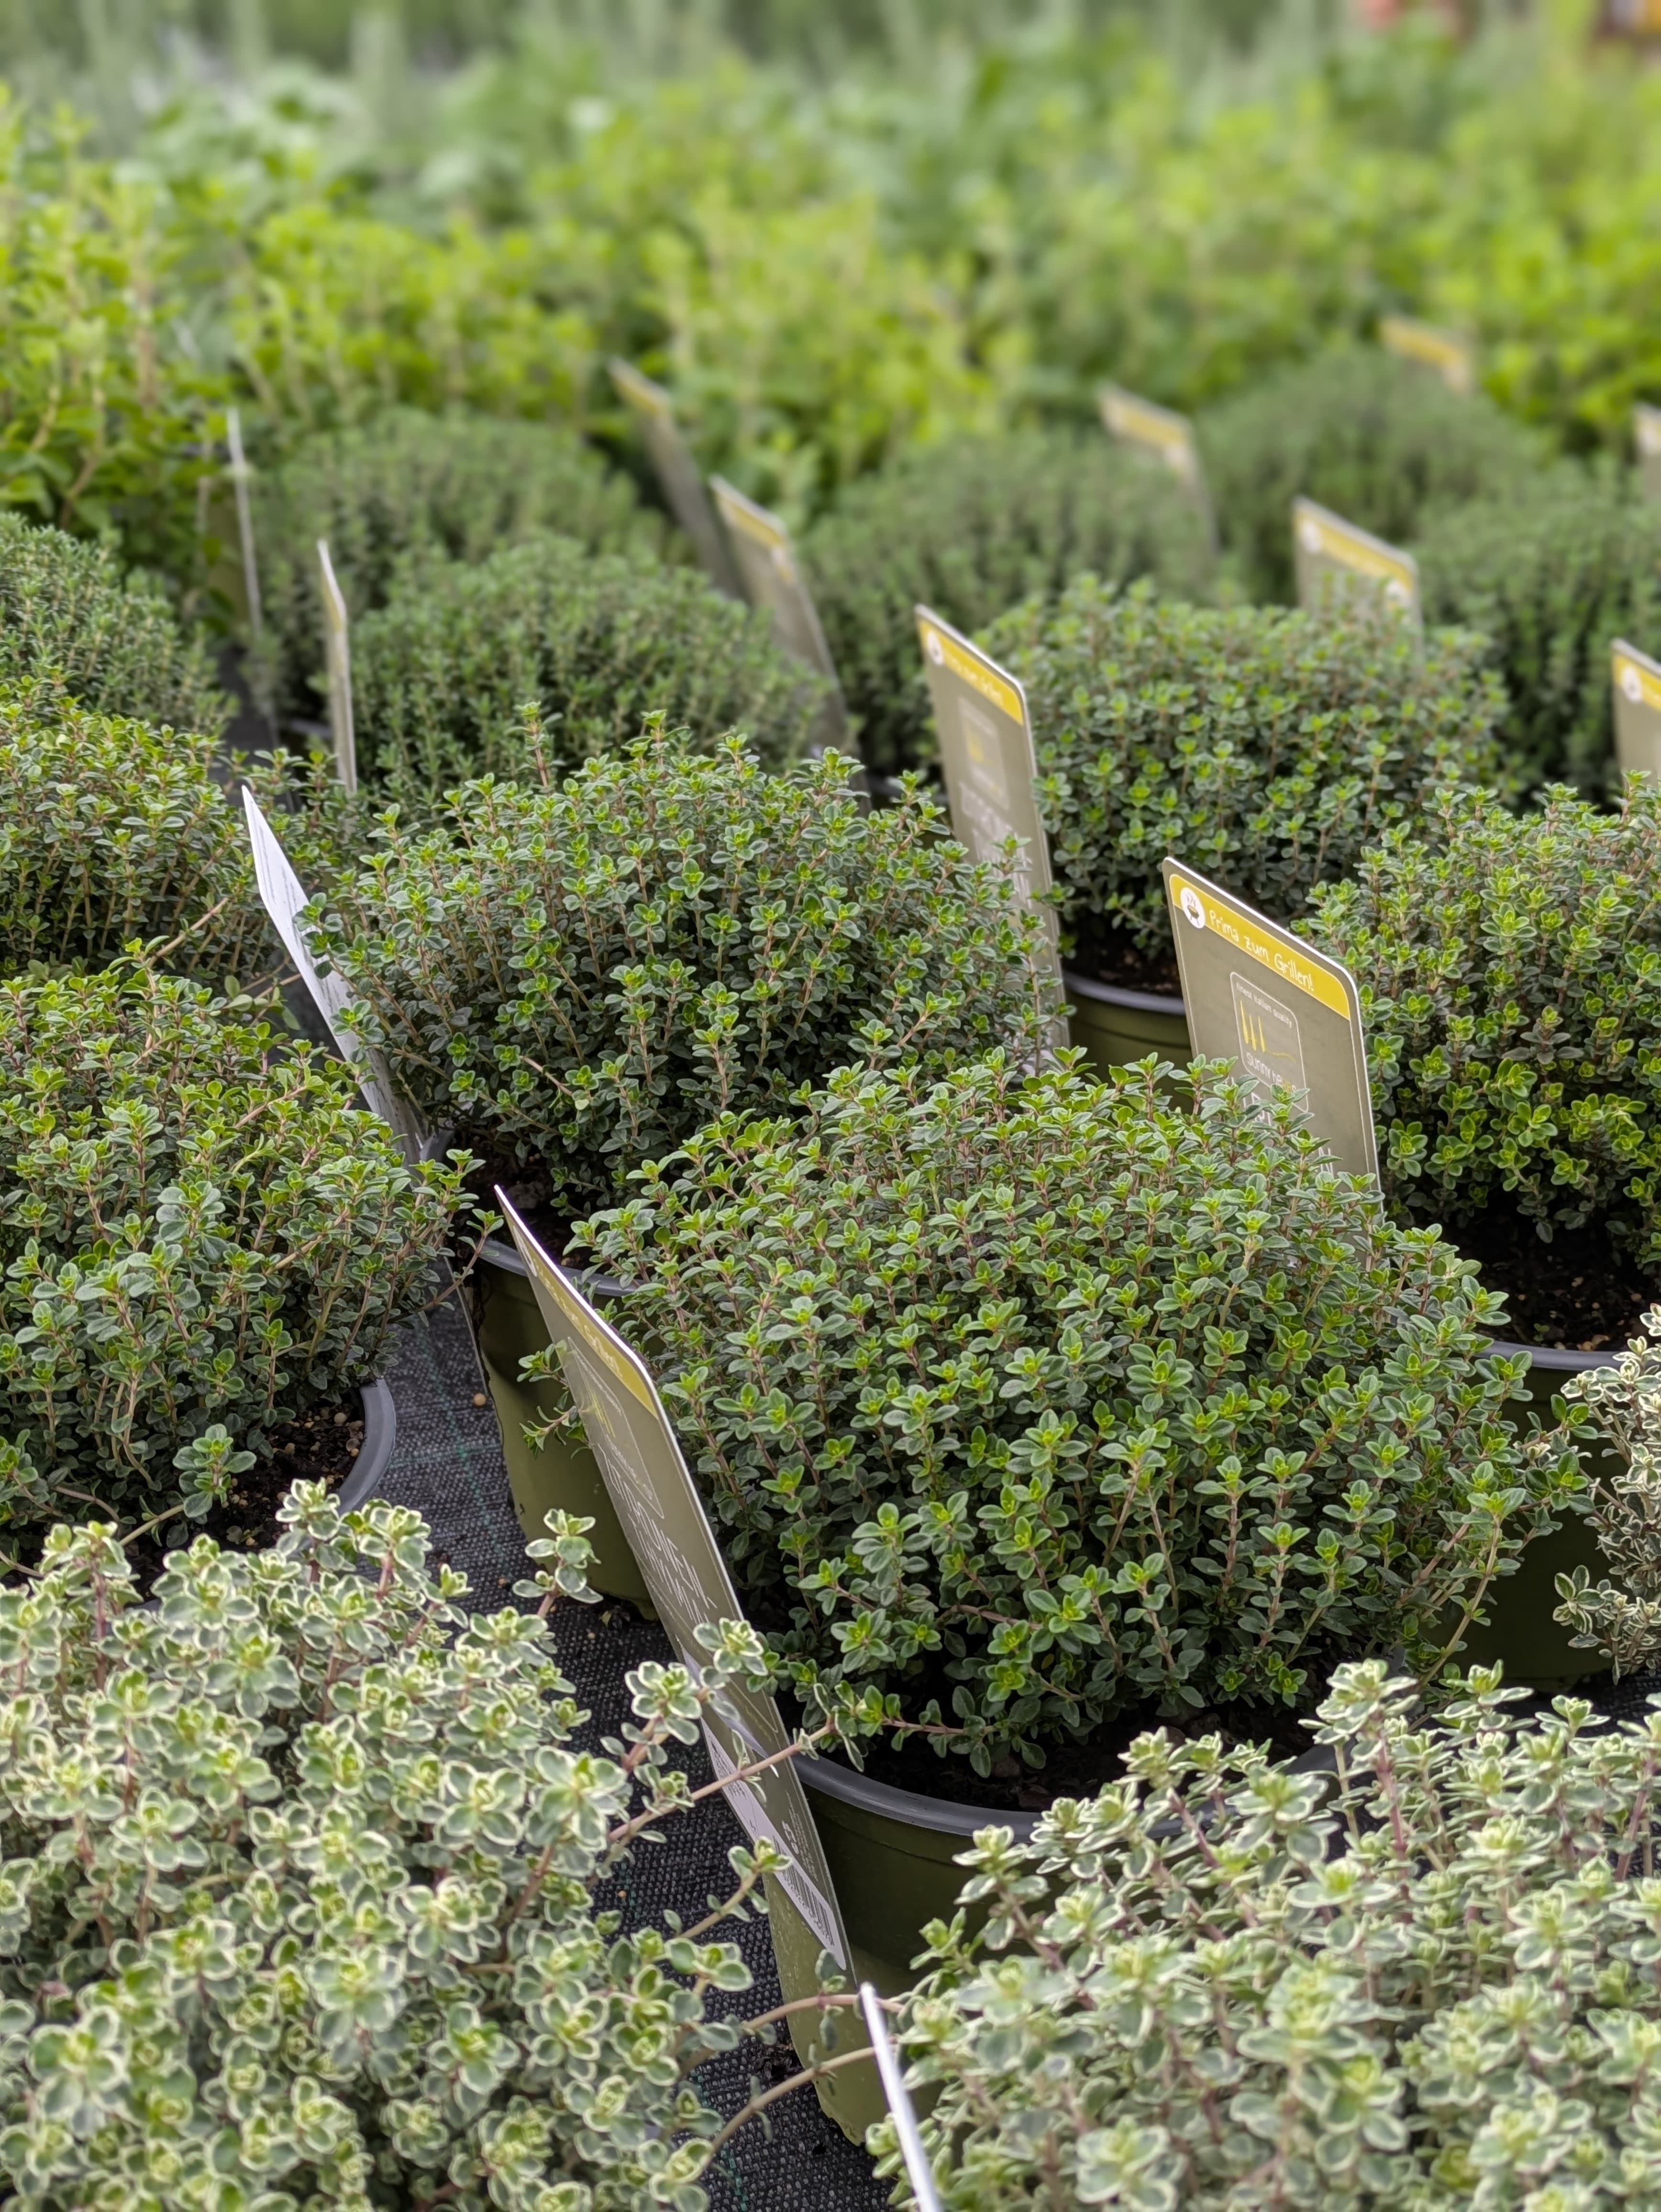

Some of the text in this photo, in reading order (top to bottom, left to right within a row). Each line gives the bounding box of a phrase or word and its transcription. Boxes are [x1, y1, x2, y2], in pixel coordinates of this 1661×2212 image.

[1209, 909, 1314, 991] Prima zum Grillen!
[628, 1513, 710, 1625] THYMIA
